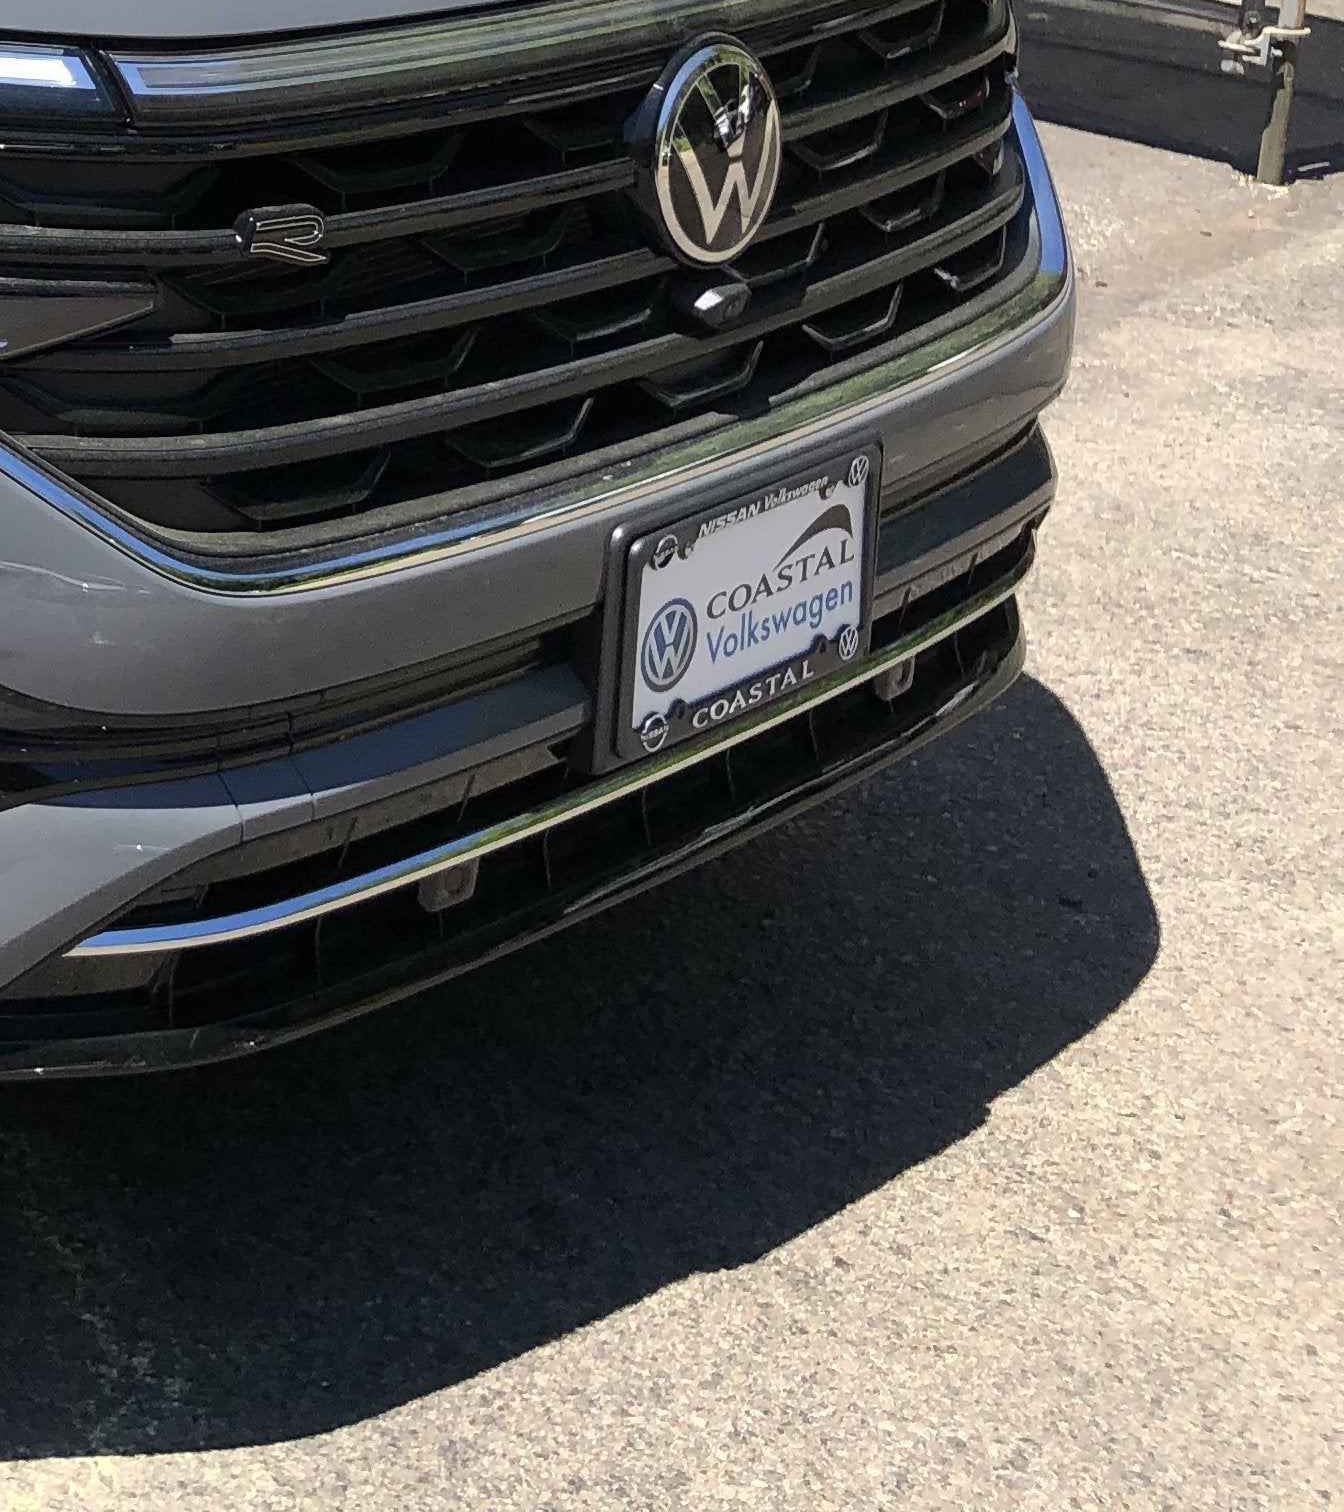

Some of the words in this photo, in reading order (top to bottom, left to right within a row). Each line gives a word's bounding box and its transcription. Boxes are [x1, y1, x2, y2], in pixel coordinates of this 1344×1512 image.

[698, 501, 761, 538] NISSAN
[706, 538, 855, 620] COASTAL
[706, 580, 853, 665] Volkswagen
[692, 660, 814, 729] COASTAL
